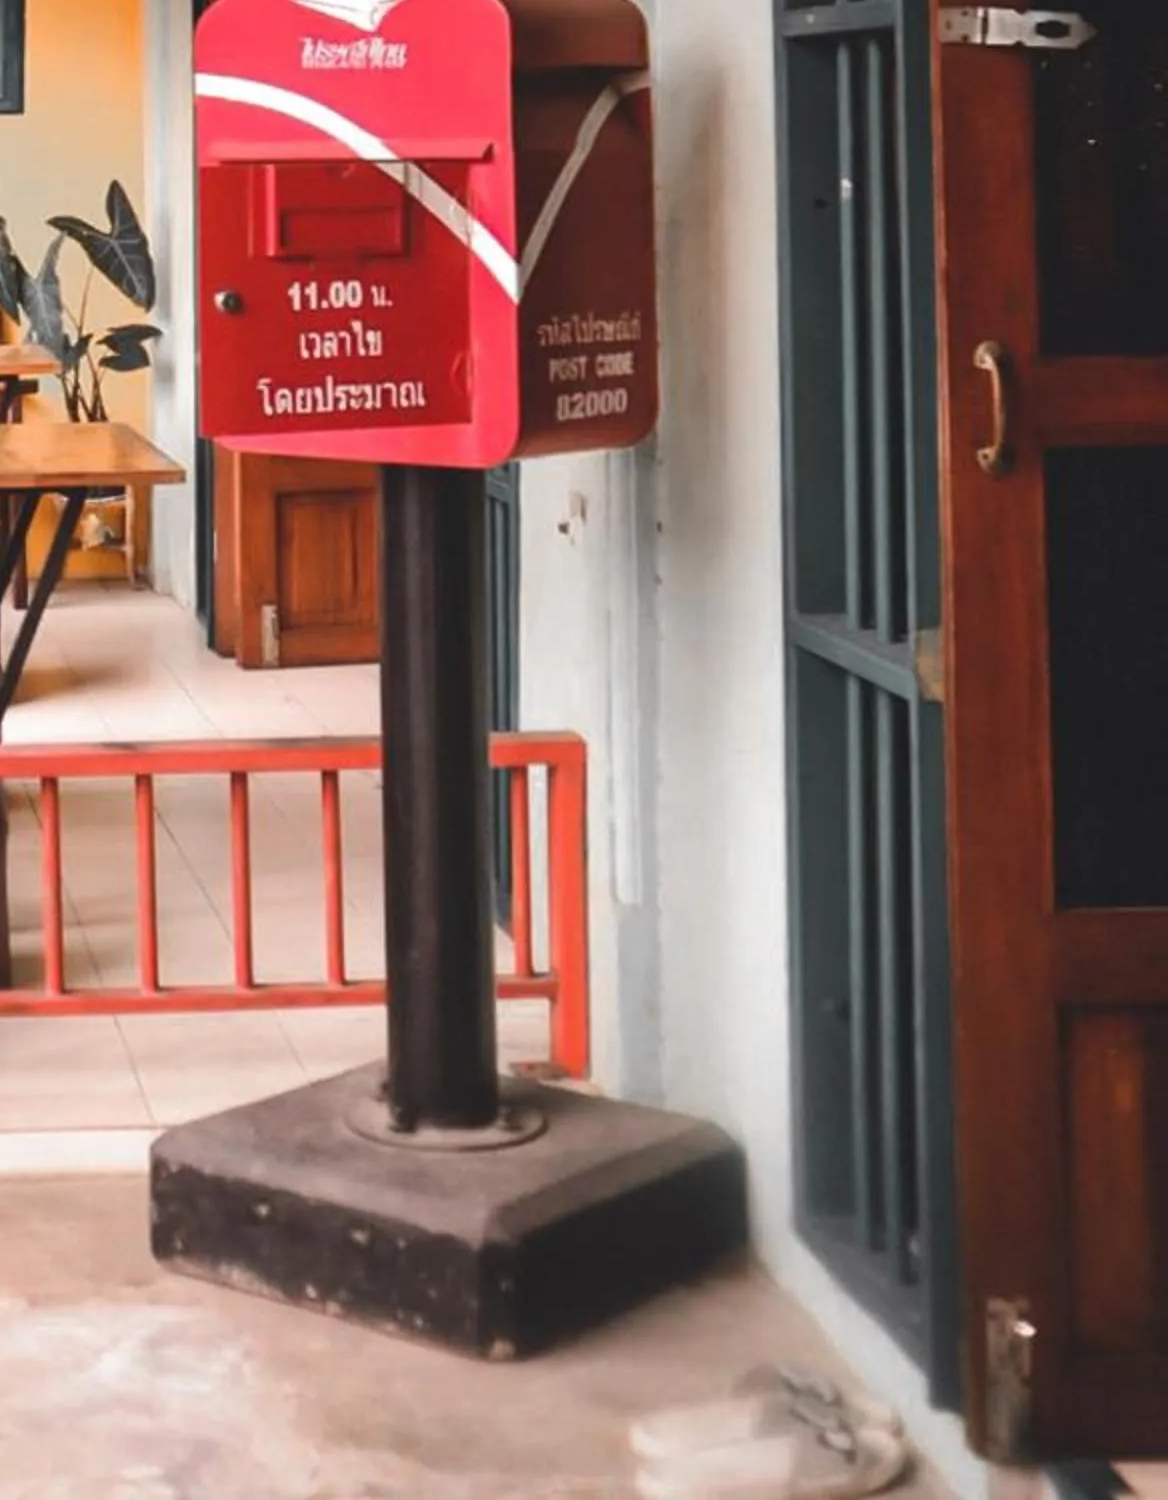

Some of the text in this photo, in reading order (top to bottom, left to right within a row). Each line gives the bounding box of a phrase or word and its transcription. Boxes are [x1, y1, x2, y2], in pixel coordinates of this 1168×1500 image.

[288, 280, 394, 312] 11.00 น.
[549, 351, 634, 383] POST CODE
[256, 375, 426, 416] โดยประมาณ
